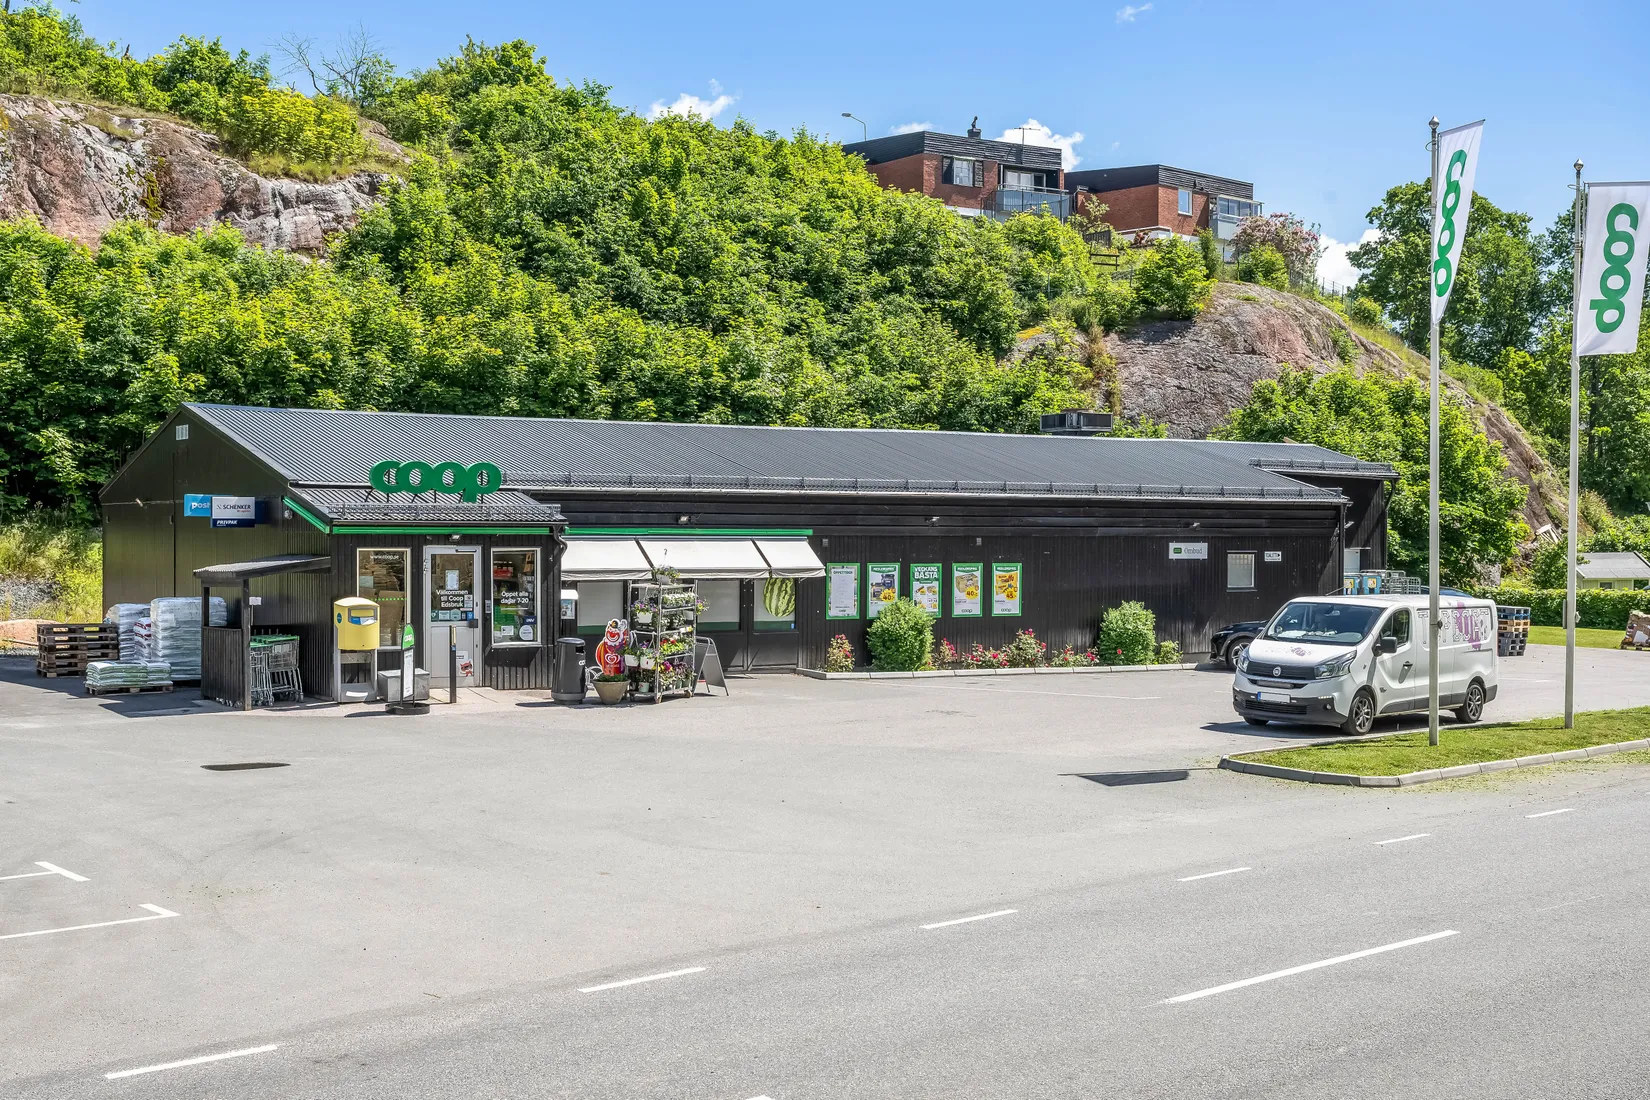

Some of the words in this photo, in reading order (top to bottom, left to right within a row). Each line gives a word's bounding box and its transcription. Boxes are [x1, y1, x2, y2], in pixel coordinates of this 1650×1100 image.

[1433, 149, 1467, 297] coop
[1589, 203, 1639, 333] coop
[369, 460, 502, 503] coop
[1183, 547, 1203, 555] Ombud
